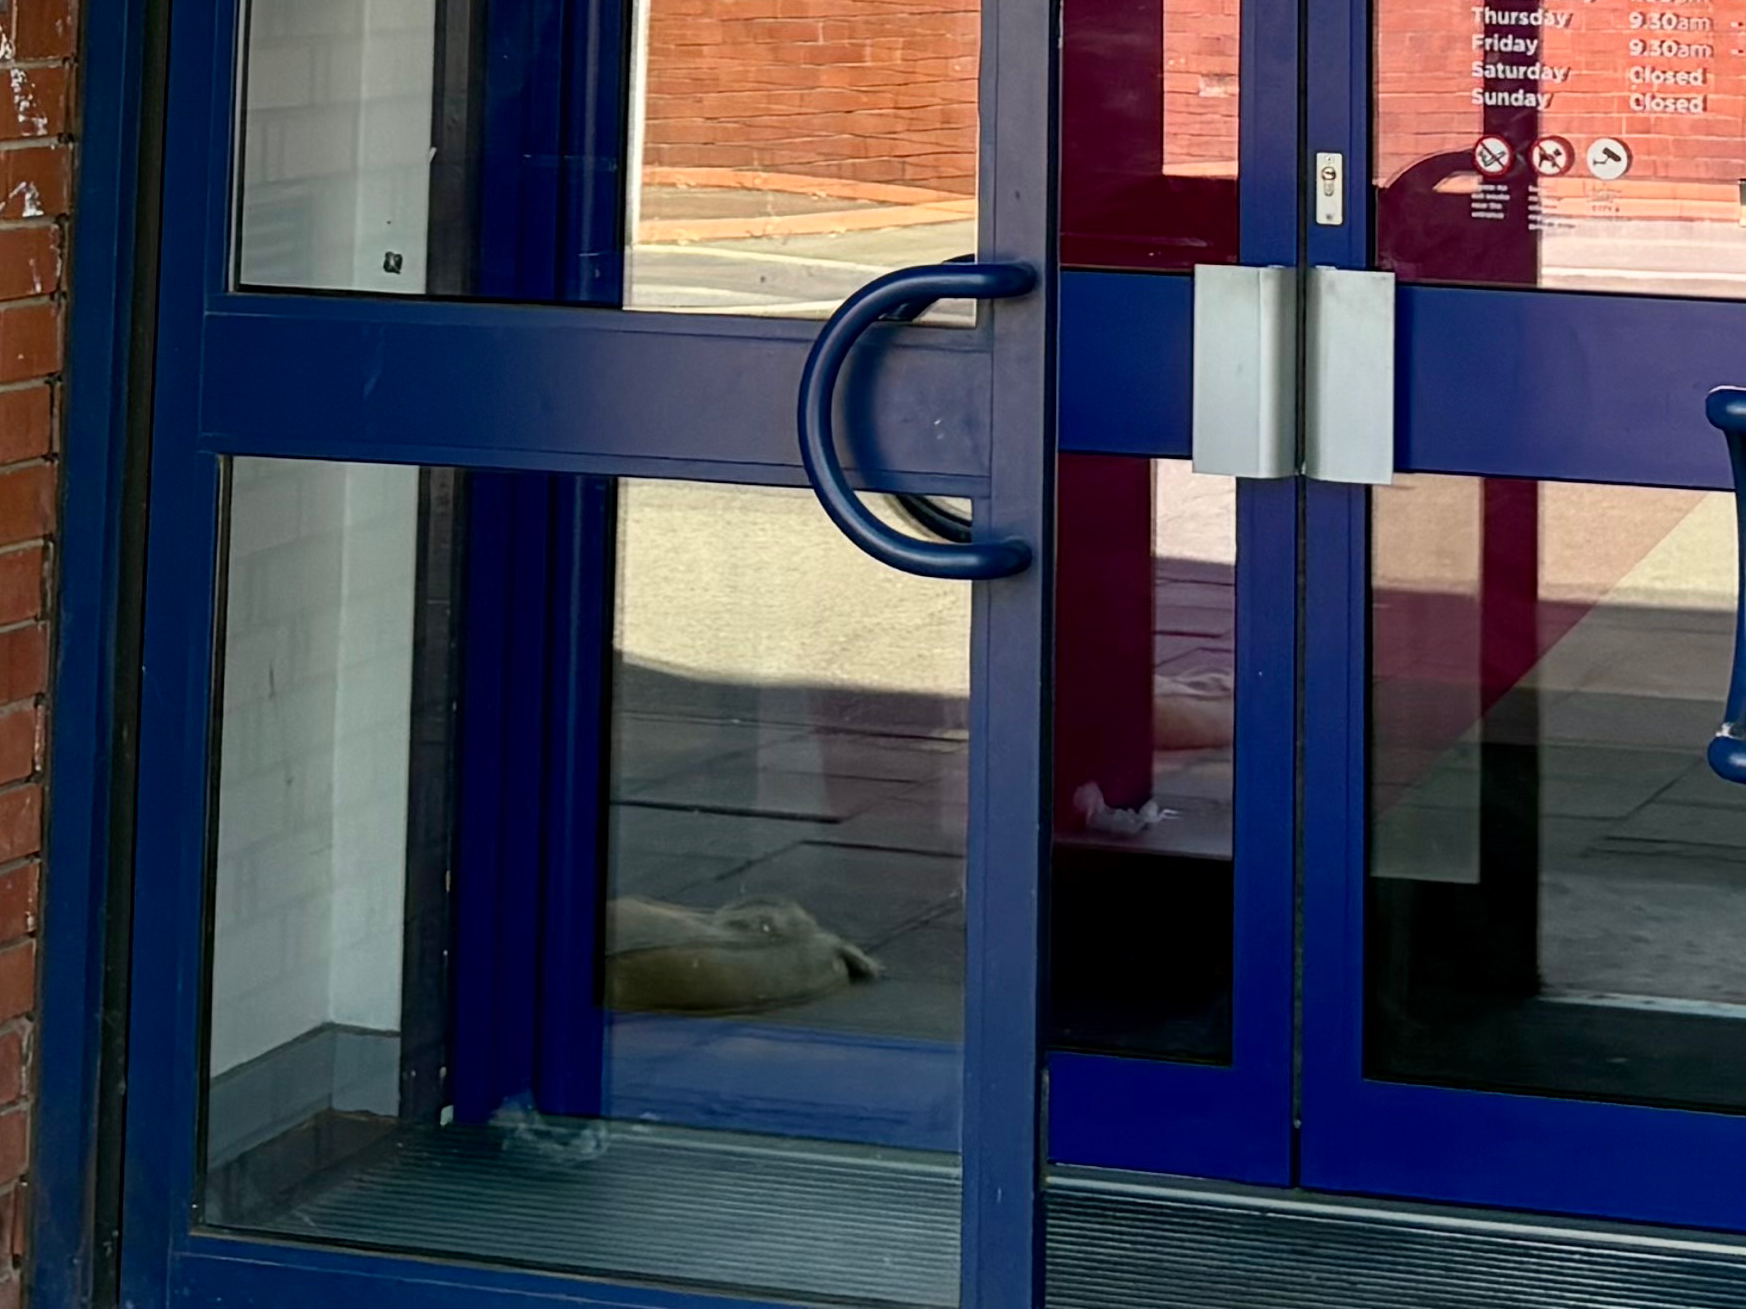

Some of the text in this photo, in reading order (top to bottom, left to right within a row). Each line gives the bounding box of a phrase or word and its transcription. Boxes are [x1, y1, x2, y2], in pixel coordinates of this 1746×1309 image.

[1470, 6, 1571, 30] Thursday
[1628, 11, 1712, 31] 9.30am
[1471, 33, 1539, 57] Friday
[1628, 38, 1713, 58] 9.30am
[1471, 60, 1705, 87] Saturday Closed
[1471, 87, 1706, 114] Sunday Closed
